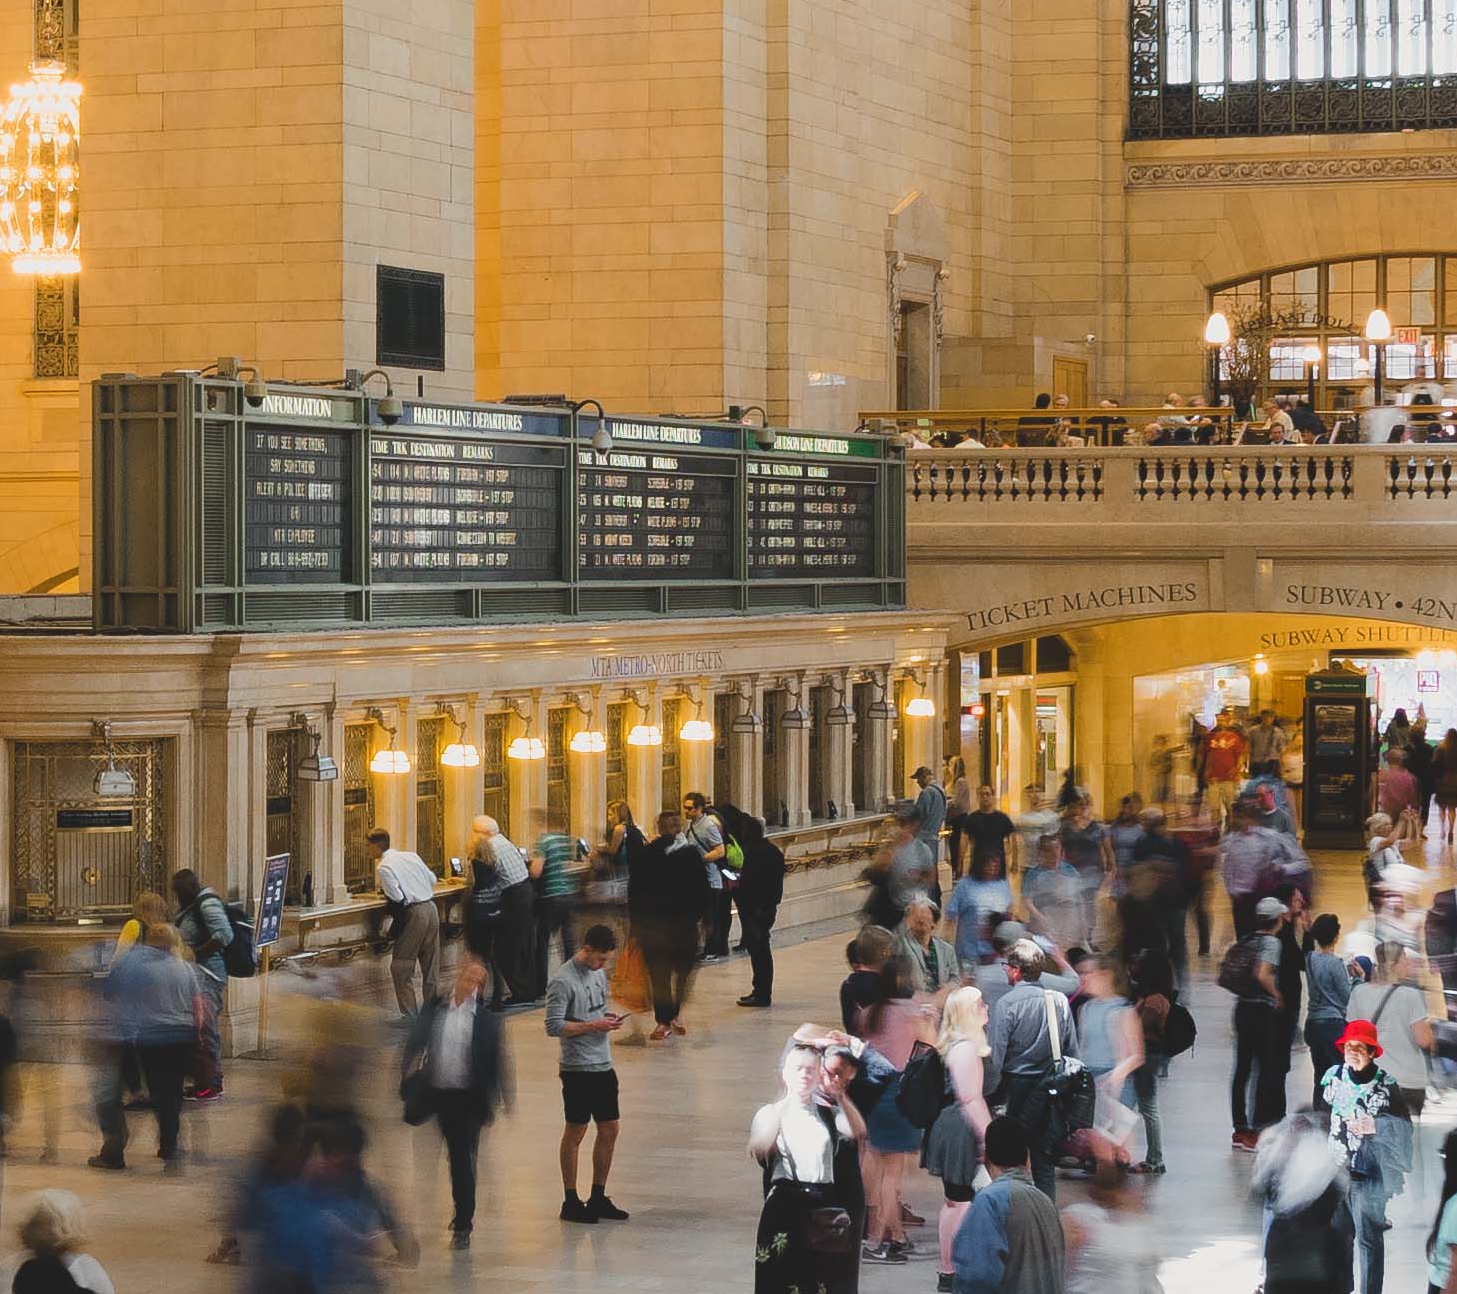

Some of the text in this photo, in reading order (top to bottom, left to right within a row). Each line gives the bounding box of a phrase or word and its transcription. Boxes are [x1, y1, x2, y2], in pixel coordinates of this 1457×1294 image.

[1398, 328, 1418, 343] EXIT
[413, 407, 522, 431] HARLEM LINE DEPARTURES
[612, 422, 702, 444] HARLEM LINE DEPARTURES
[371, 441, 494, 459] TIME TRK DESTINATION REMARKS
[966, 583, 1198, 631] TICKET MACHINES
[1286, 584, 1391, 610] SUBWAY
[1260, 625, 1449, 649] SUBWAY SHUTTLE
[591, 651, 723, 677] MTA METRO-NORTH TICKETS
